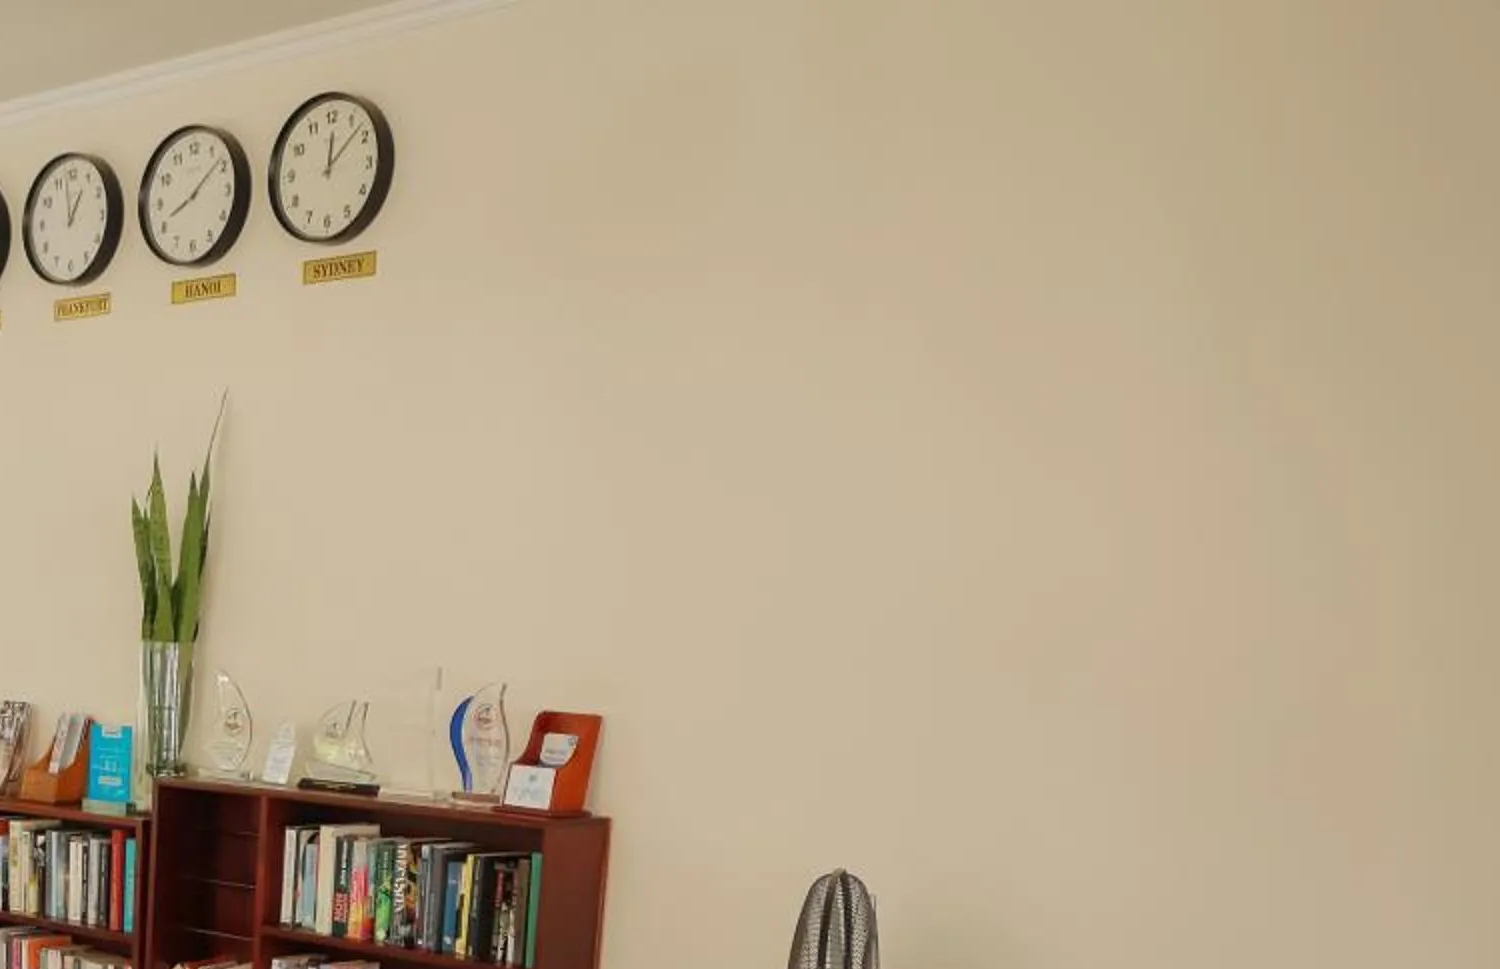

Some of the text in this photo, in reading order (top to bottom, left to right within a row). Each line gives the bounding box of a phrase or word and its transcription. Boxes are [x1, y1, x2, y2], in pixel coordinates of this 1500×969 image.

[326, 110, 338, 124] 12
[308, 123, 318, 136] 11
[361, 130, 369, 144] 2
[366, 155, 373, 169] 3
[359, 183, 366, 196] 4
[306, 210, 313, 224] 7
[344, 204, 351, 218] 5
[323, 214, 331, 228] 6
[312, 257, 366, 279] SYDNEY
[184, 279, 221, 299] HANOI
